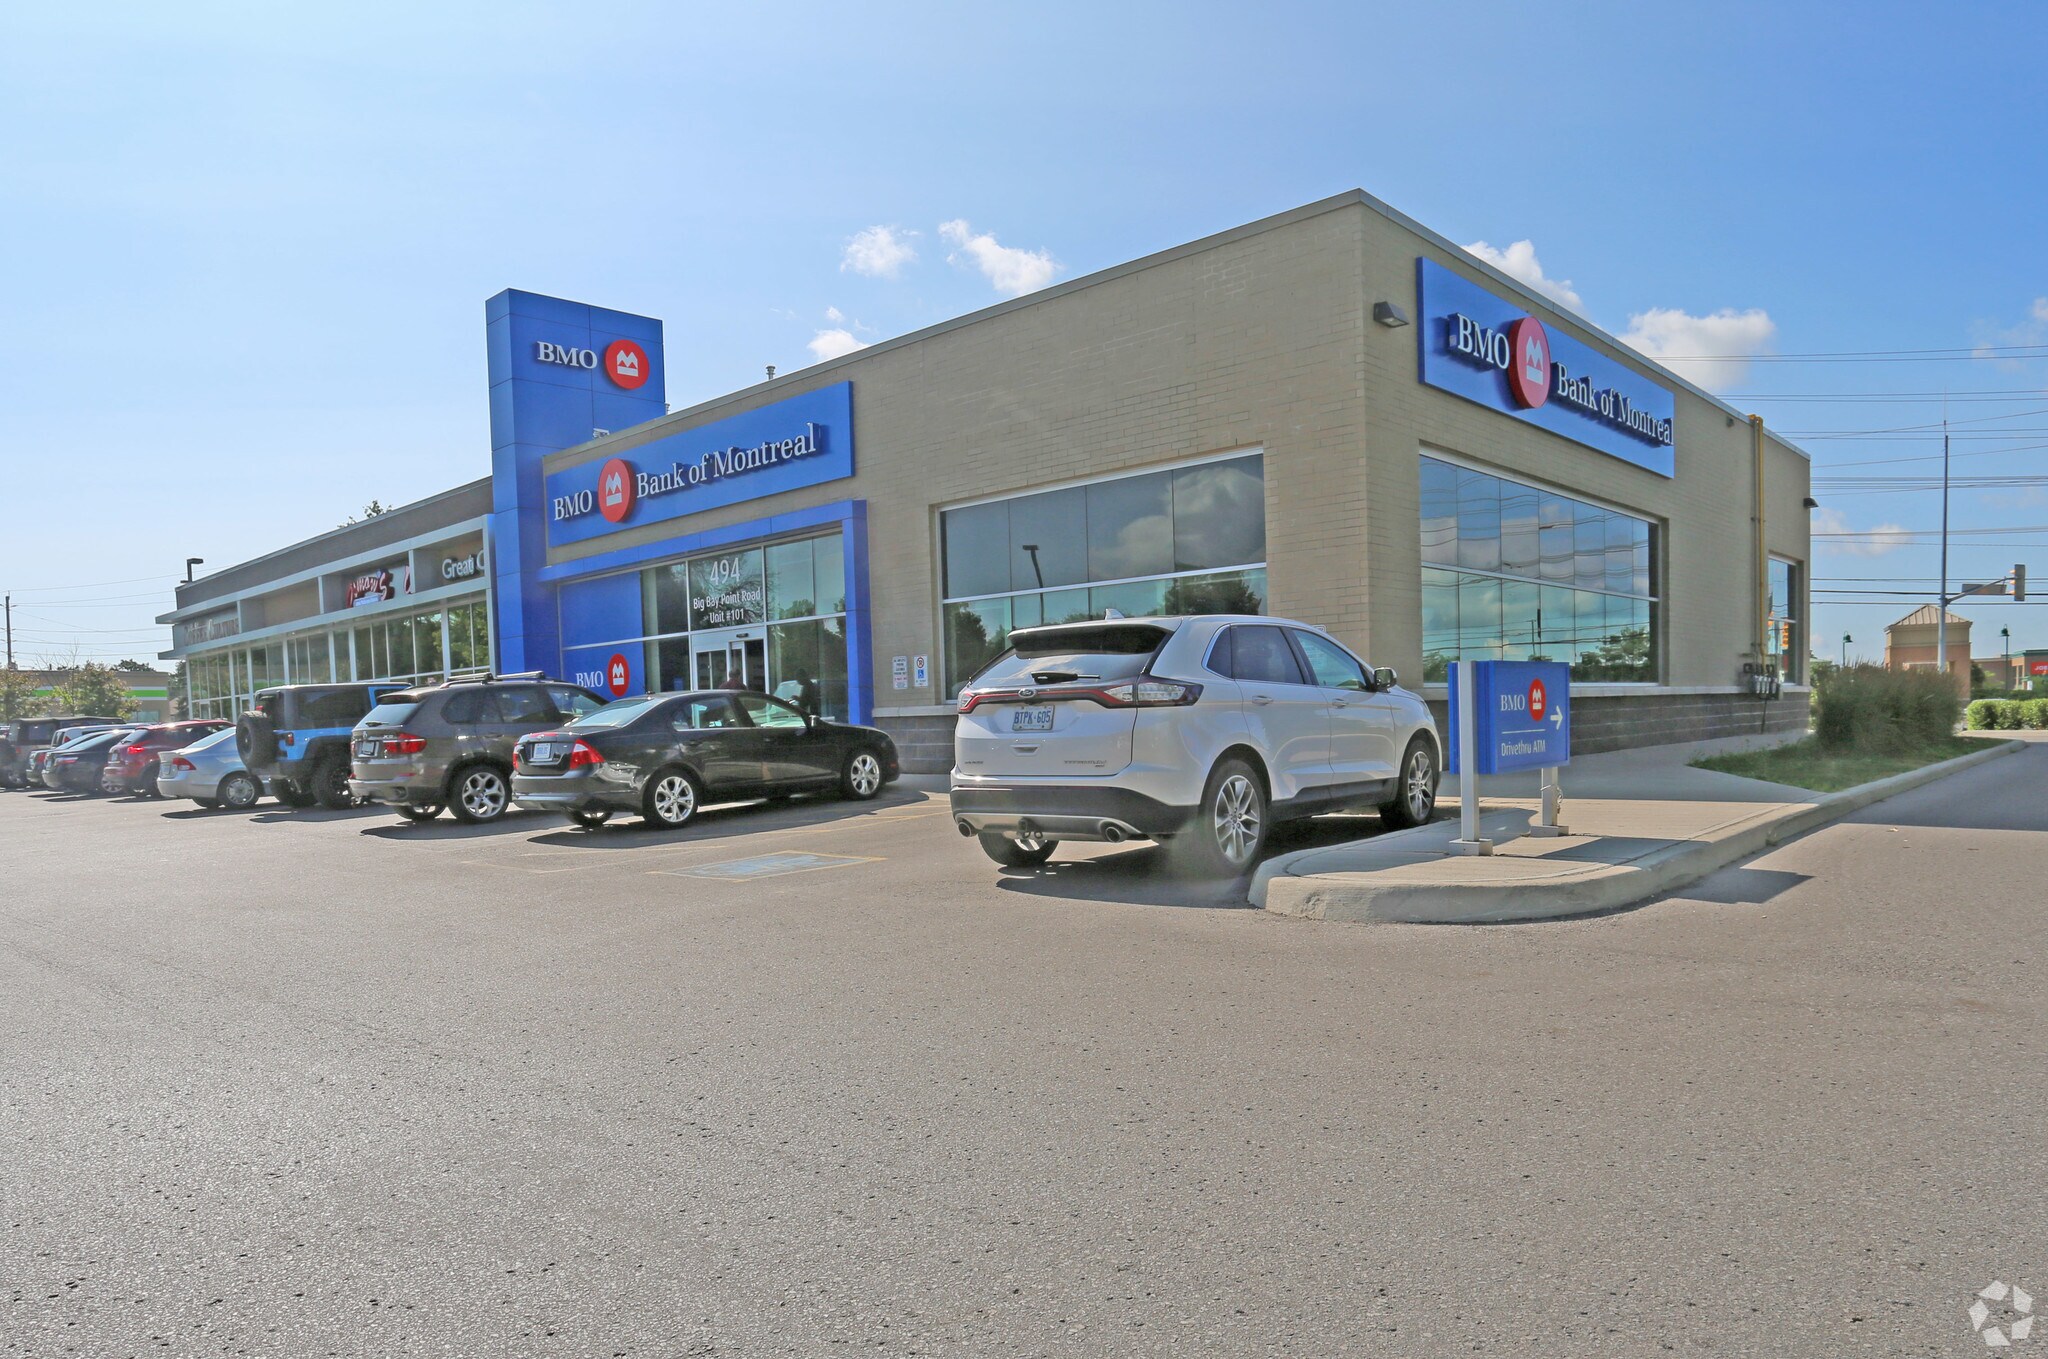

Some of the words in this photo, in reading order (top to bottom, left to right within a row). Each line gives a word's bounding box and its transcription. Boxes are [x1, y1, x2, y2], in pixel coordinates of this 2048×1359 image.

[537, 341, 598, 369] BMO
[1457, 313, 1510, 369] BMO
[1557, 362, 1598, 411] Bank
[1601, 388, 1616, 418] of
[1618, 392, 1674, 445] Montreal
[553, 489, 593, 520] BMO
[636, 462, 686, 498] Bank
[688, 453, 709, 484] of
[712, 422, 816, 478] Montreal
[442, 554, 475, 579] Great
[710, 557, 740, 585] 494
[693, 597, 705, 611] Big
[706, 595, 720, 608] Bay
[721, 591, 740, 605] Point
[741, 587, 761, 602] Road
[709, 611, 725, 623] Unit
[726, 608, 744, 621] #101
[576, 670, 604, 688] BMO
[1500, 694, 1525, 711] BMO
[1533, 739, 1545, 753] ATM
